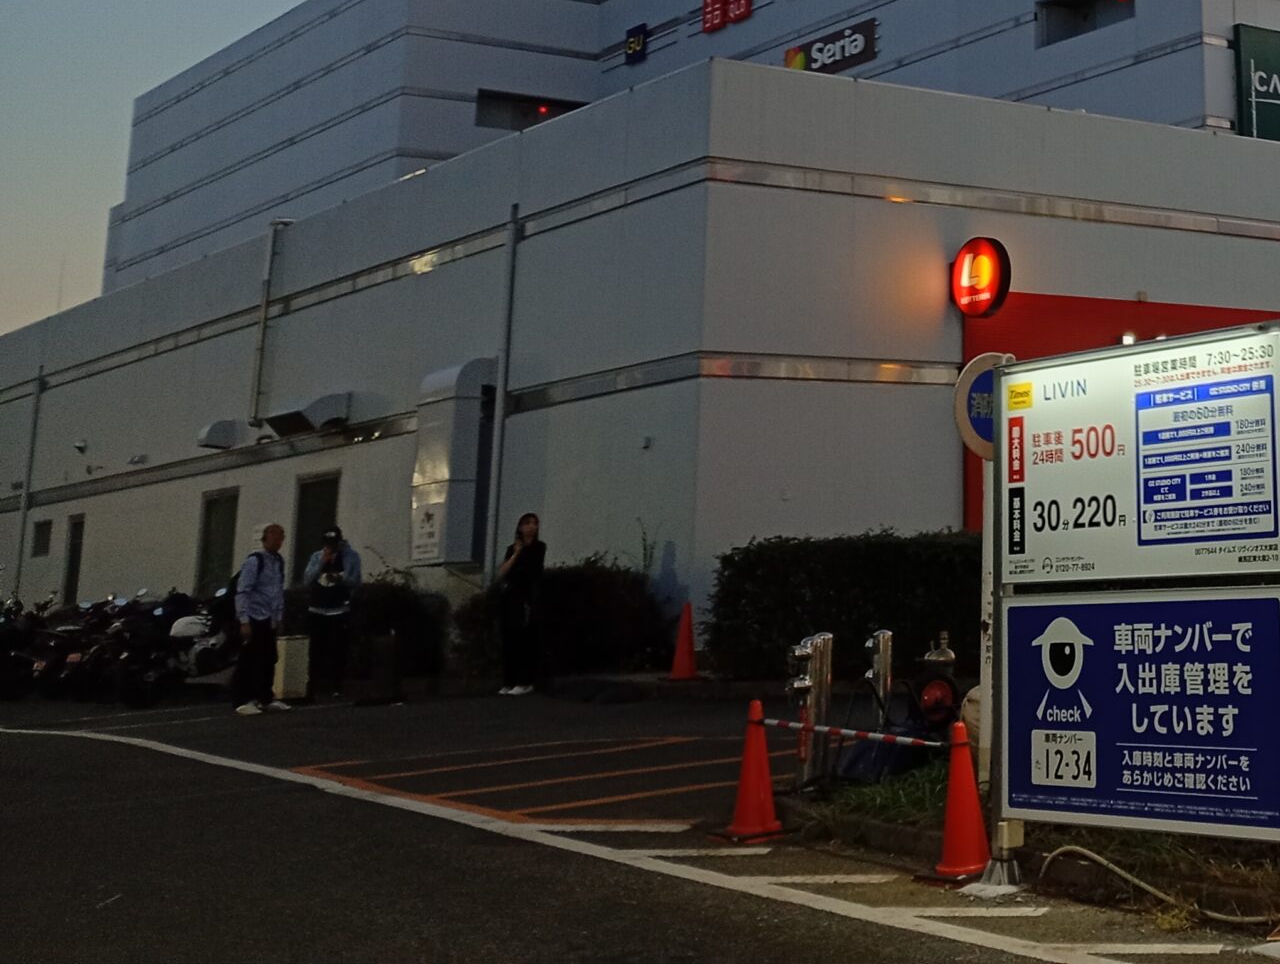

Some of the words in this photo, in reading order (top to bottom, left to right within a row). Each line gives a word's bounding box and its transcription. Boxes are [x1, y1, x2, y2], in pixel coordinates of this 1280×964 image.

[626, 36, 643, 54] GU
[811, 31, 865, 68] Seria
[1043, 379, 1087, 401] LIVIN
[1032, 448, 1064, 465] 24時間
[1114, 621, 1252, 654] 車両ナンバーで
[1116, 663, 1253, 695] 入出庫管理を
[1047, 705, 1081, 723] check
[1132, 703, 1239, 736] しています
[1044, 733, 1083, 744] 車両ナンバー
[1122, 751, 1249, 772] 入庫時刻と車両ナンバーを
[1122, 770, 1250, 791] あらかじめご確認ください
